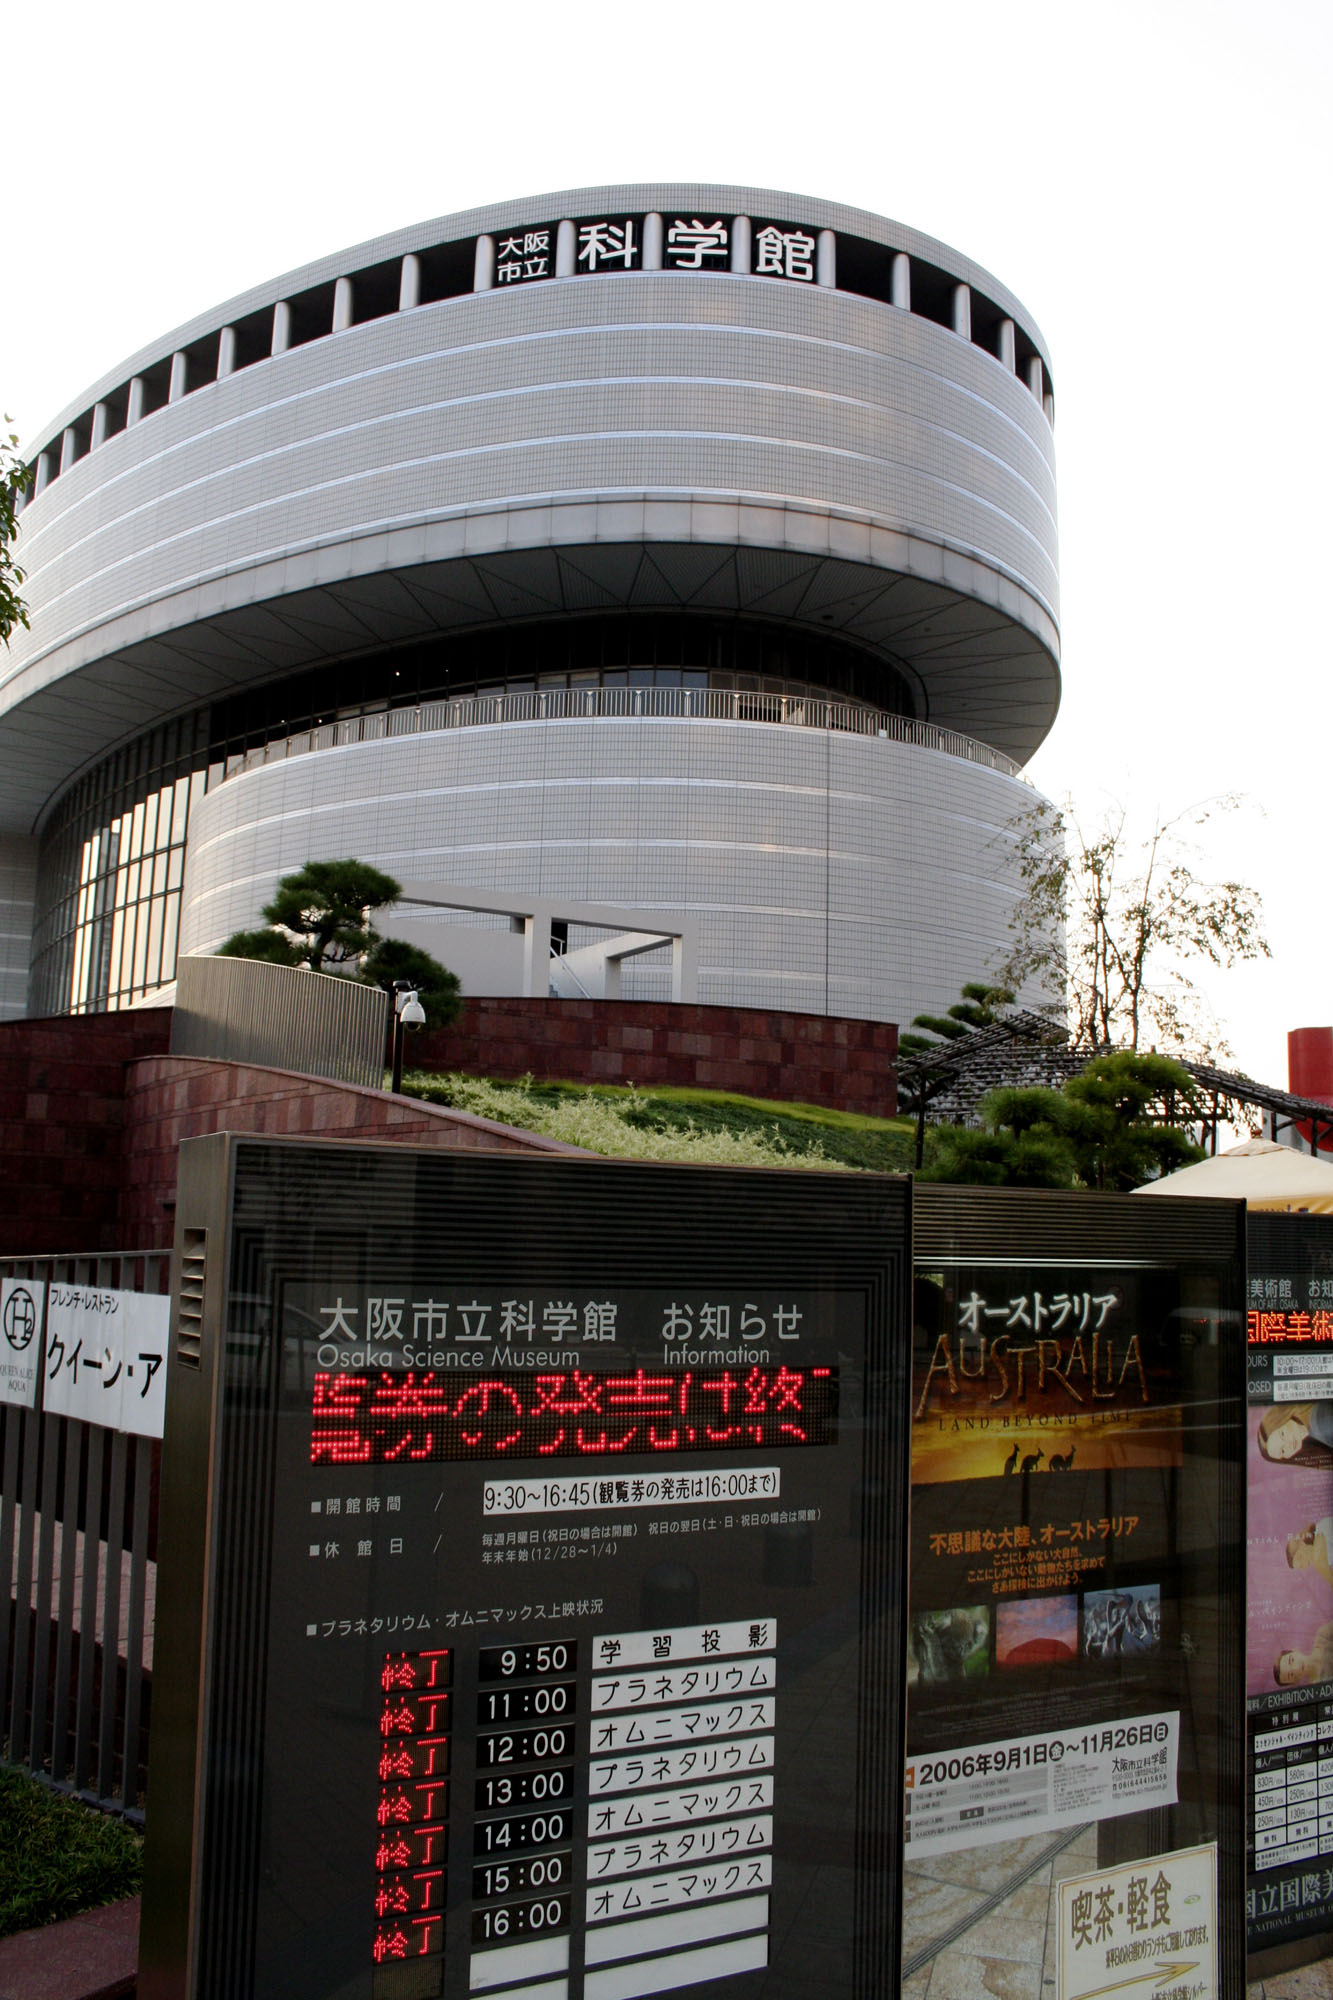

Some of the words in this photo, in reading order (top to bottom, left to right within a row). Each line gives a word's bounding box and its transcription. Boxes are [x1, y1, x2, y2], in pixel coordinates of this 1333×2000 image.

[498, 230, 549, 259] 大阪
[578, 219, 815, 281] 科学館
[497, 256, 549, 282] 市立
[51, 1289, 119, 1315] フレンチ・レストラン
[1248, 1279, 1292, 1298] 美術館
[318, 1297, 618, 1344] 大阪市立科学館
[661, 1302, 804, 1342] お知らせ
[958, 1291, 1118, 1331] オーストラリア
[47, 1332, 163, 1399] クイーン・ア
[317, 1344, 393, 1368] Osaka
[401, 1344, 484, 1368] Science
[491, 1344, 580, 1367] Museum
[663, 1342, 770, 1365] Information
[914, 1332, 1149, 1419] AUSTRALIA
[311, 1366, 830, 1462] 覧券の発売は終
[939, 1418, 990, 1432] LAND
[1003, 1414, 1078, 1428] BEYOND
[326, 1495, 401, 1515] 開館時間
[324, 1537, 403, 1559] 休館日
[929, 1516, 1140, 1557] 不思議な大陸、オーストラリア
[321, 1598, 604, 1637] プラネタリウム・オムニマックス上映状況
[500, 1645, 568, 1676] 9:50
[600, 1623, 768, 1664] 学習投影
[487, 1686, 566, 1719] 11:00
[598, 1667, 768, 1707] プラネタリウム
[597, 1703, 767, 1748] オムニマックス
[486, 1729, 565, 1762] 12:00
[1112, 1746, 1167, 1773] 大阪市立科学館
[595, 1745, 766, 1788] プラネタリウム
[485, 1772, 564, 1806] 13:00
[595, 1782, 765, 1831] オムニマックス
[484, 1815, 563, 1849] 14:00
[594, 1823, 764, 1871] プラネタリウム
[483, 1857, 562, 1894] 15:00
[593, 1861, 763, 1916] オムニマックス
[482, 1900, 561, 1936] 16:00
[1071, 1870, 1171, 1951] 喫茶・軽食
